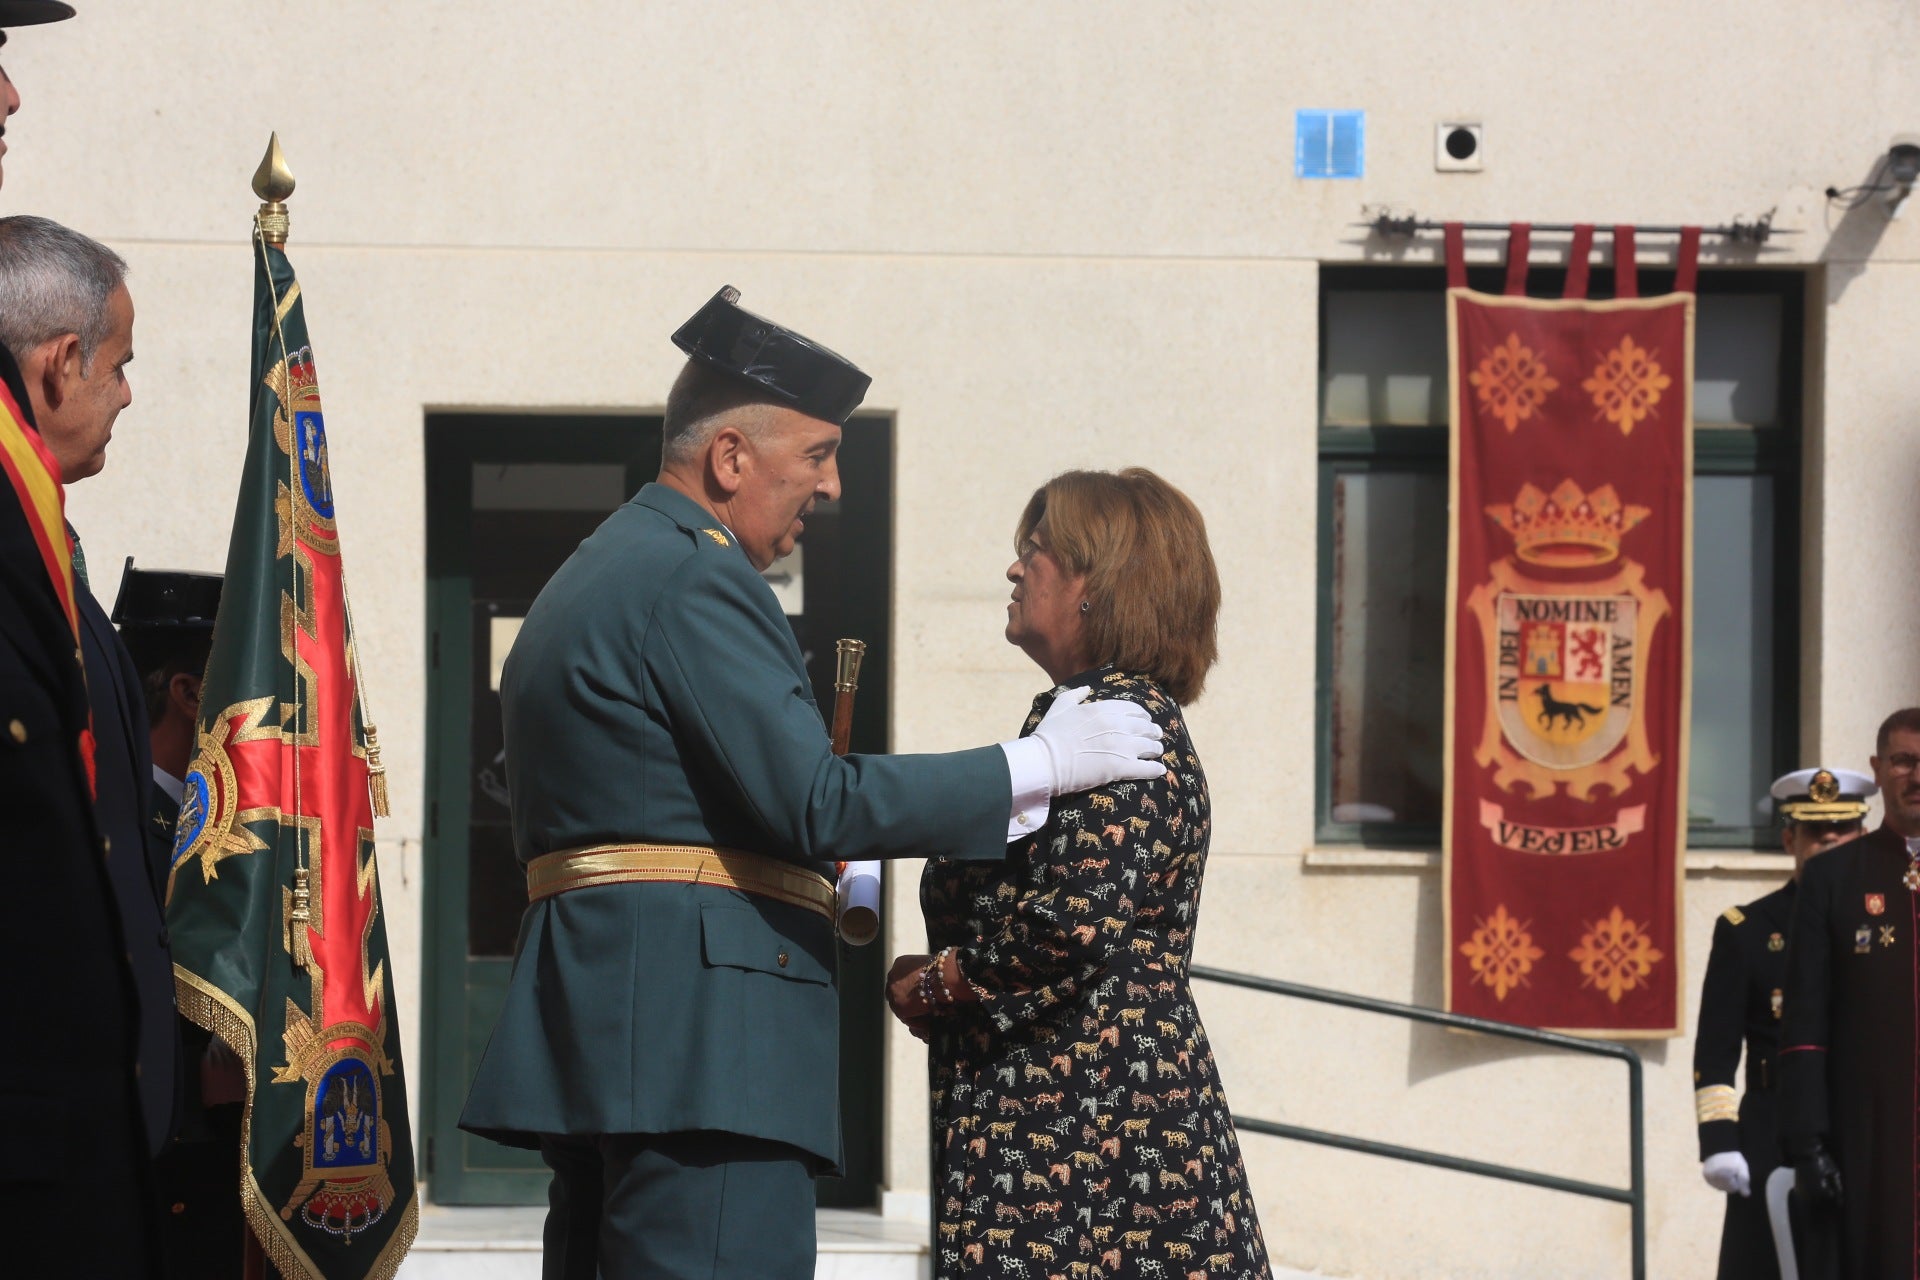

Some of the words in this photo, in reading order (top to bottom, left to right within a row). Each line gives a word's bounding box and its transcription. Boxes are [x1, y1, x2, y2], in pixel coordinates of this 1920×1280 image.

[1516, 599, 1618, 622] NOMINE
[1500, 630, 1520, 666] DEI
[1610, 634, 1632, 708] AMEN
[1499, 677, 1518, 701] IN
[1498, 822, 1623, 853] VEJER
